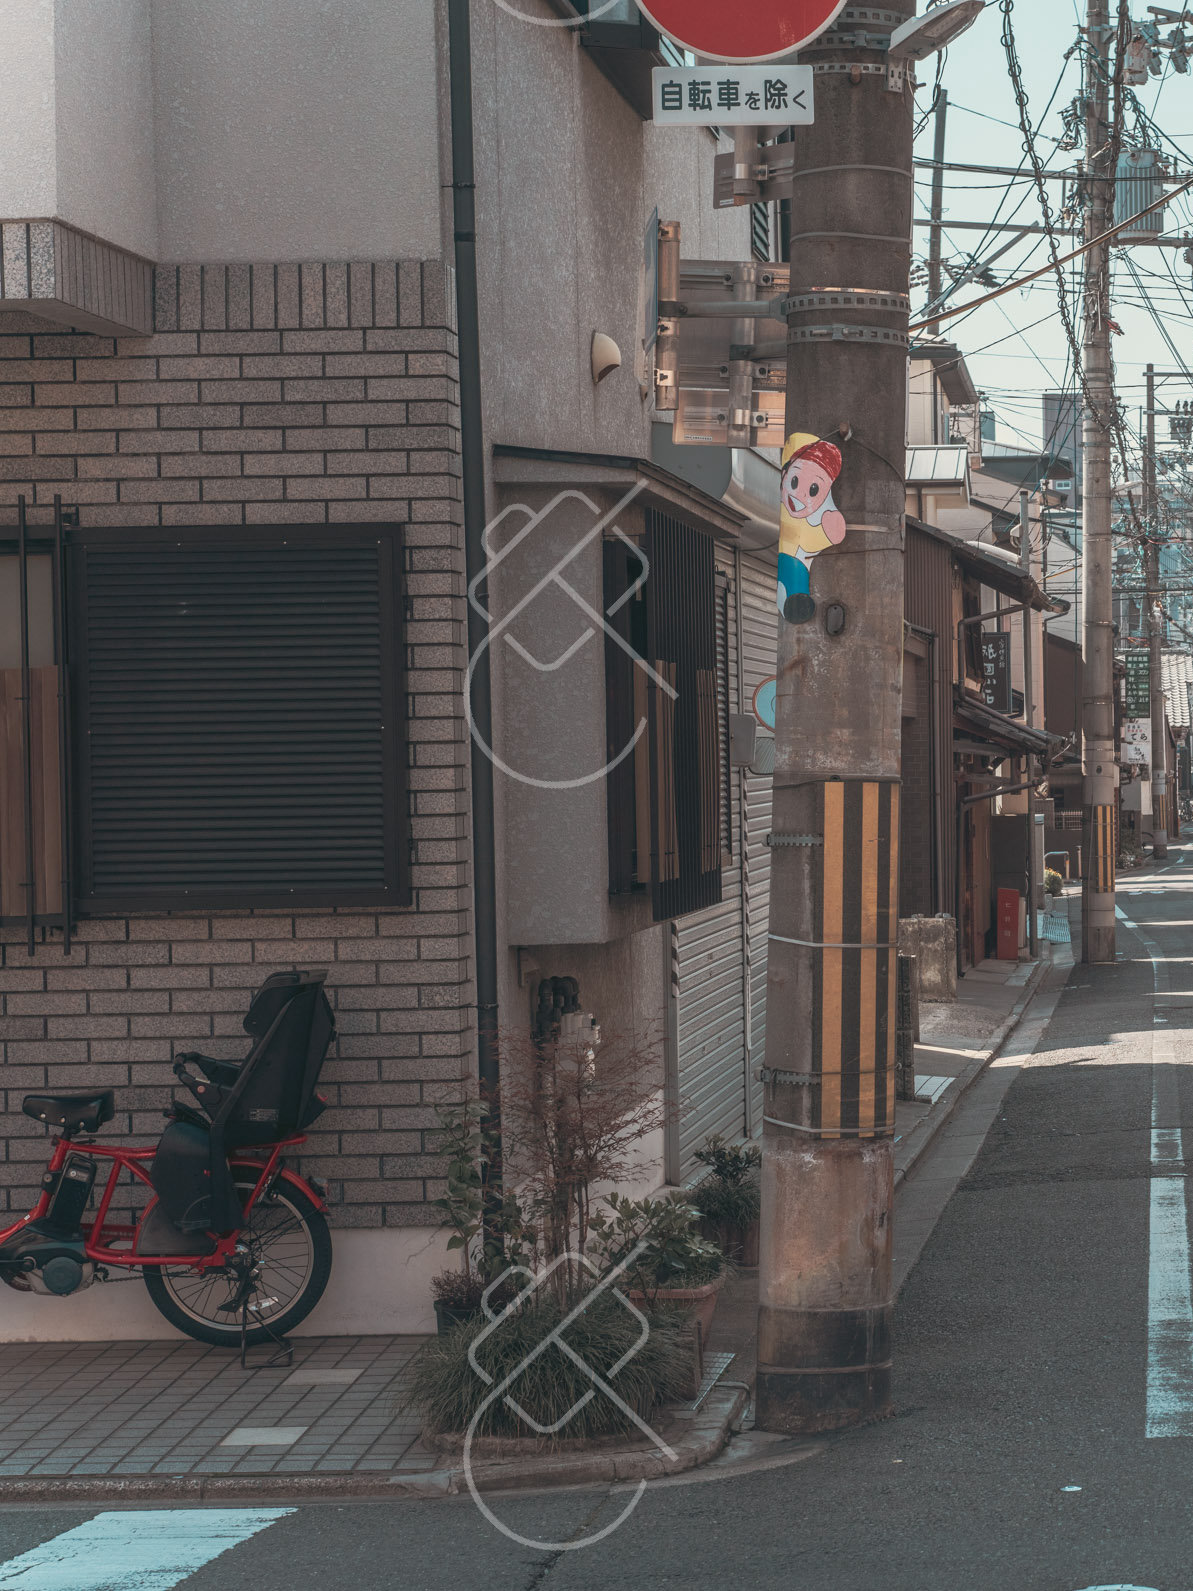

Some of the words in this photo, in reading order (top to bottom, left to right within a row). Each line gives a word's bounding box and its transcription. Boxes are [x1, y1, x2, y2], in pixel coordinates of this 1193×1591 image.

[660, 78, 808, 112] 自転車を除く
